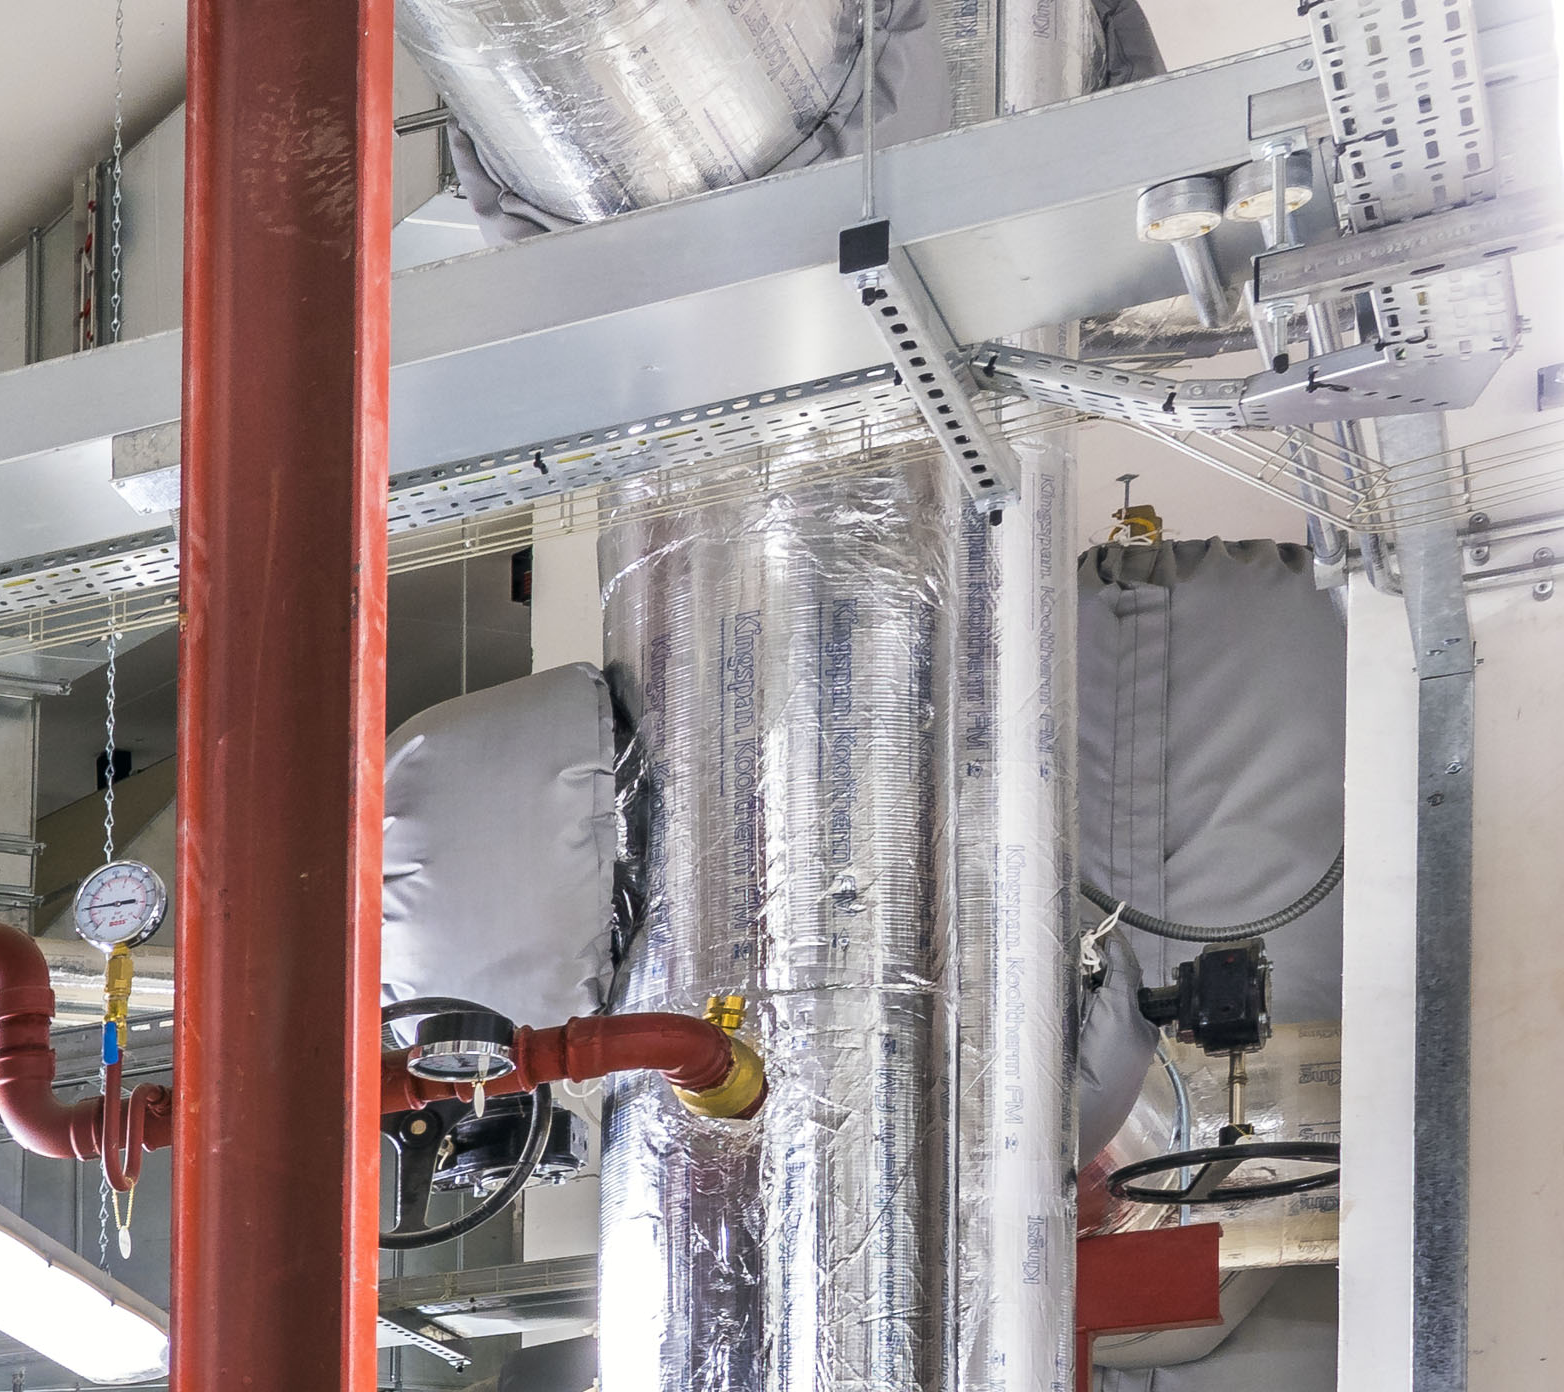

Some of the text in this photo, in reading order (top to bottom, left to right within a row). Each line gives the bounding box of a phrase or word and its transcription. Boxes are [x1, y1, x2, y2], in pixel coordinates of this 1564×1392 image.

[967, 710, 986, 751] FM
[1036, 714, 1055, 754] FM
[733, 887, 758, 930] FM
[1004, 1085, 1025, 1124] FM
